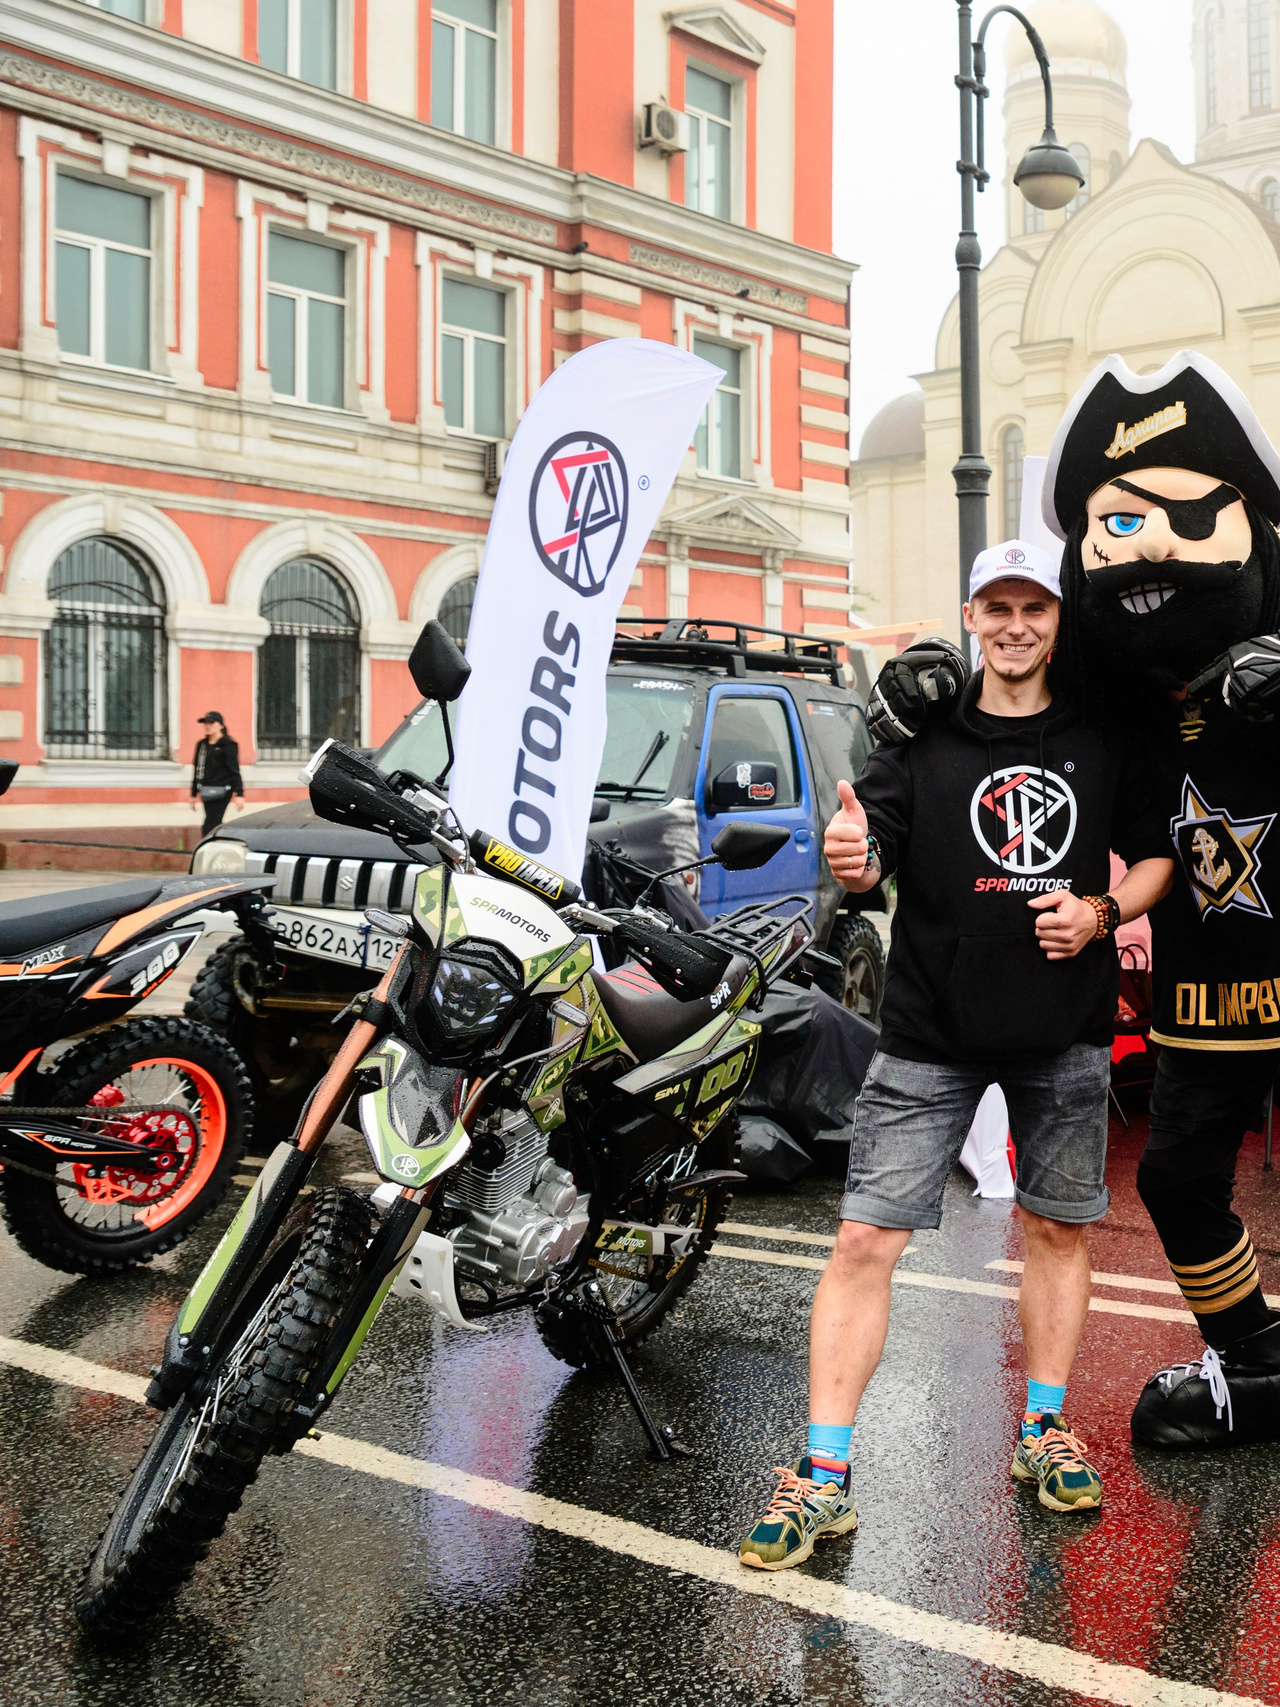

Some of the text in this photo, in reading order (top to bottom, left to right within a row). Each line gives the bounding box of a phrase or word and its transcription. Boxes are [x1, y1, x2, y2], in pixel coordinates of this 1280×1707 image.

[487, 843, 562, 896] PROTAPER
[974, 877, 1073, 892] SPRMOTORS
[469, 896, 551, 943] SPRMOTORS
[17, 945, 66, 981] MAX
[130, 941, 180, 997] 300
[710, 981, 731, 1010] SPR
